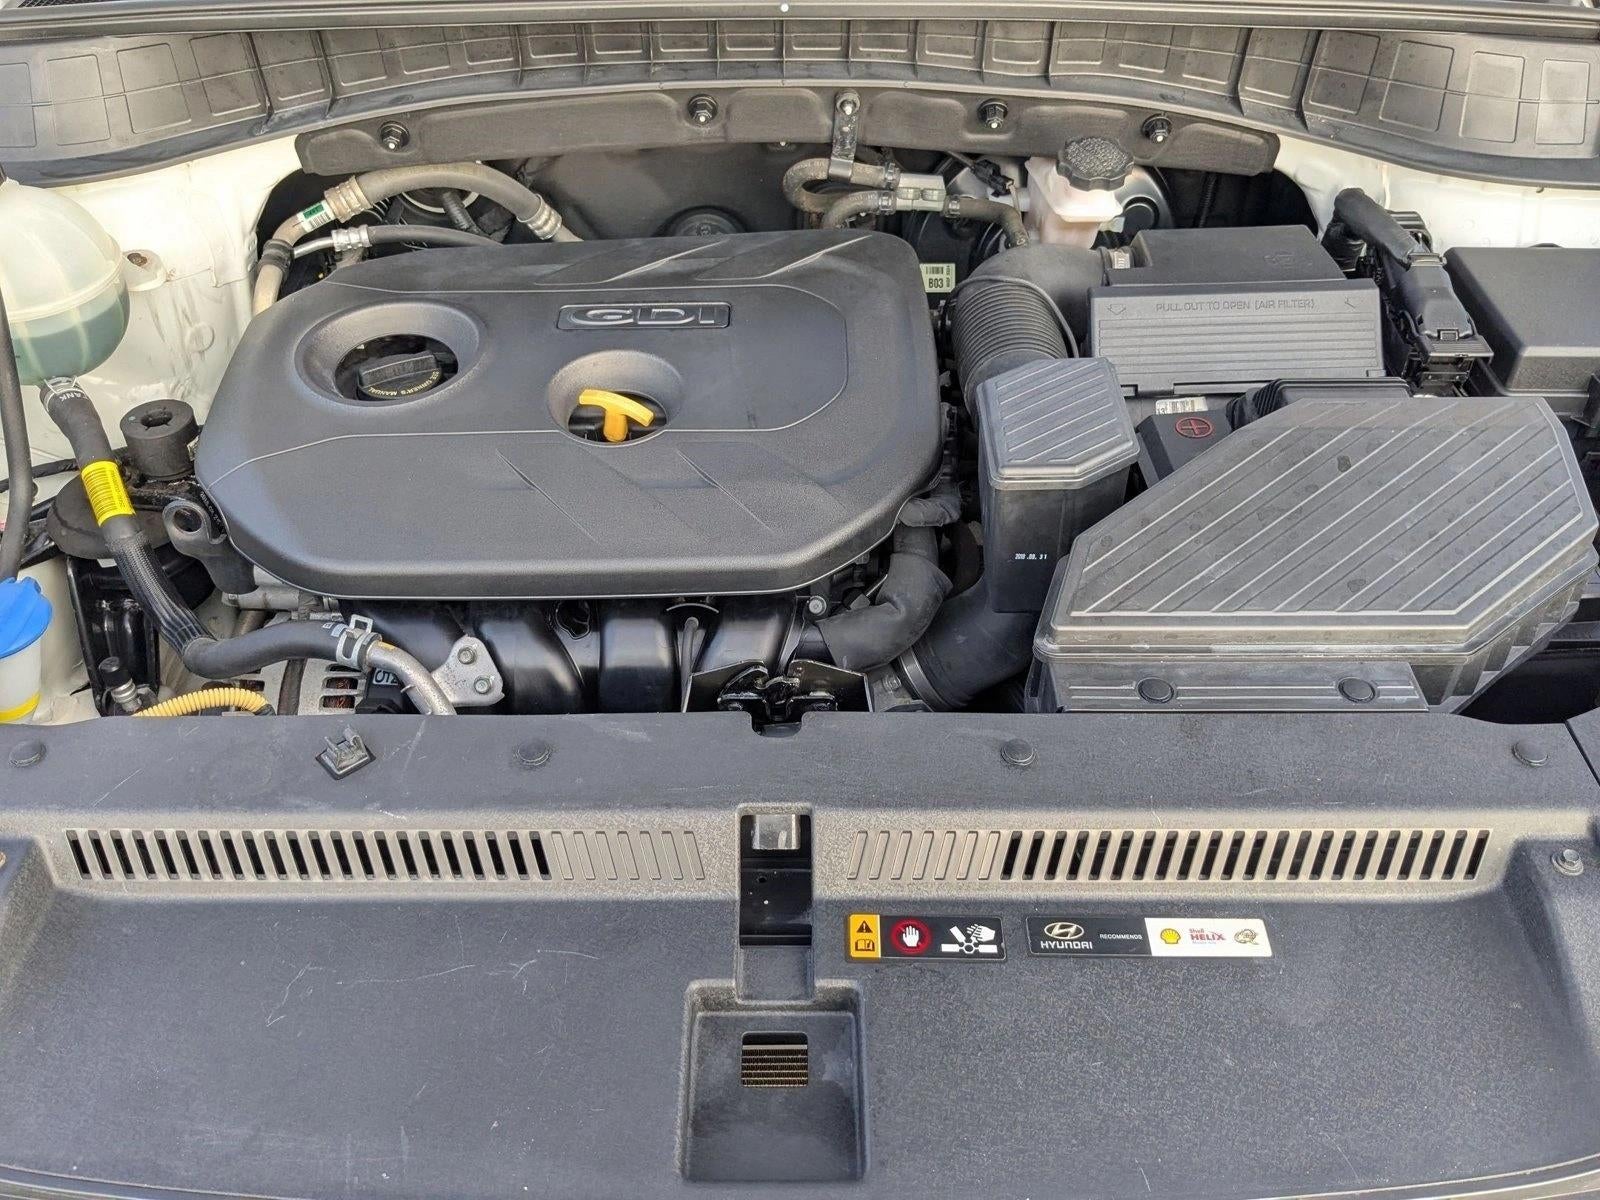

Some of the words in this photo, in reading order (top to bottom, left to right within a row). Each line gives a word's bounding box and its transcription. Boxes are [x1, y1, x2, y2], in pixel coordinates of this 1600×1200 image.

[928, 278, 944, 289] B03
[1156, 303, 1182, 312] PULL
[1184, 302, 1204, 311] OUT
[1207, 301, 1221, 311] TO
[1223, 300, 1250, 310] OPEN
[567, 307, 717, 326] GDI
[368, 386, 398, 396] MANUAL
[1190, 931, 1226, 941] HELIX
[1040, 940, 1093, 950] HYUNDAI
